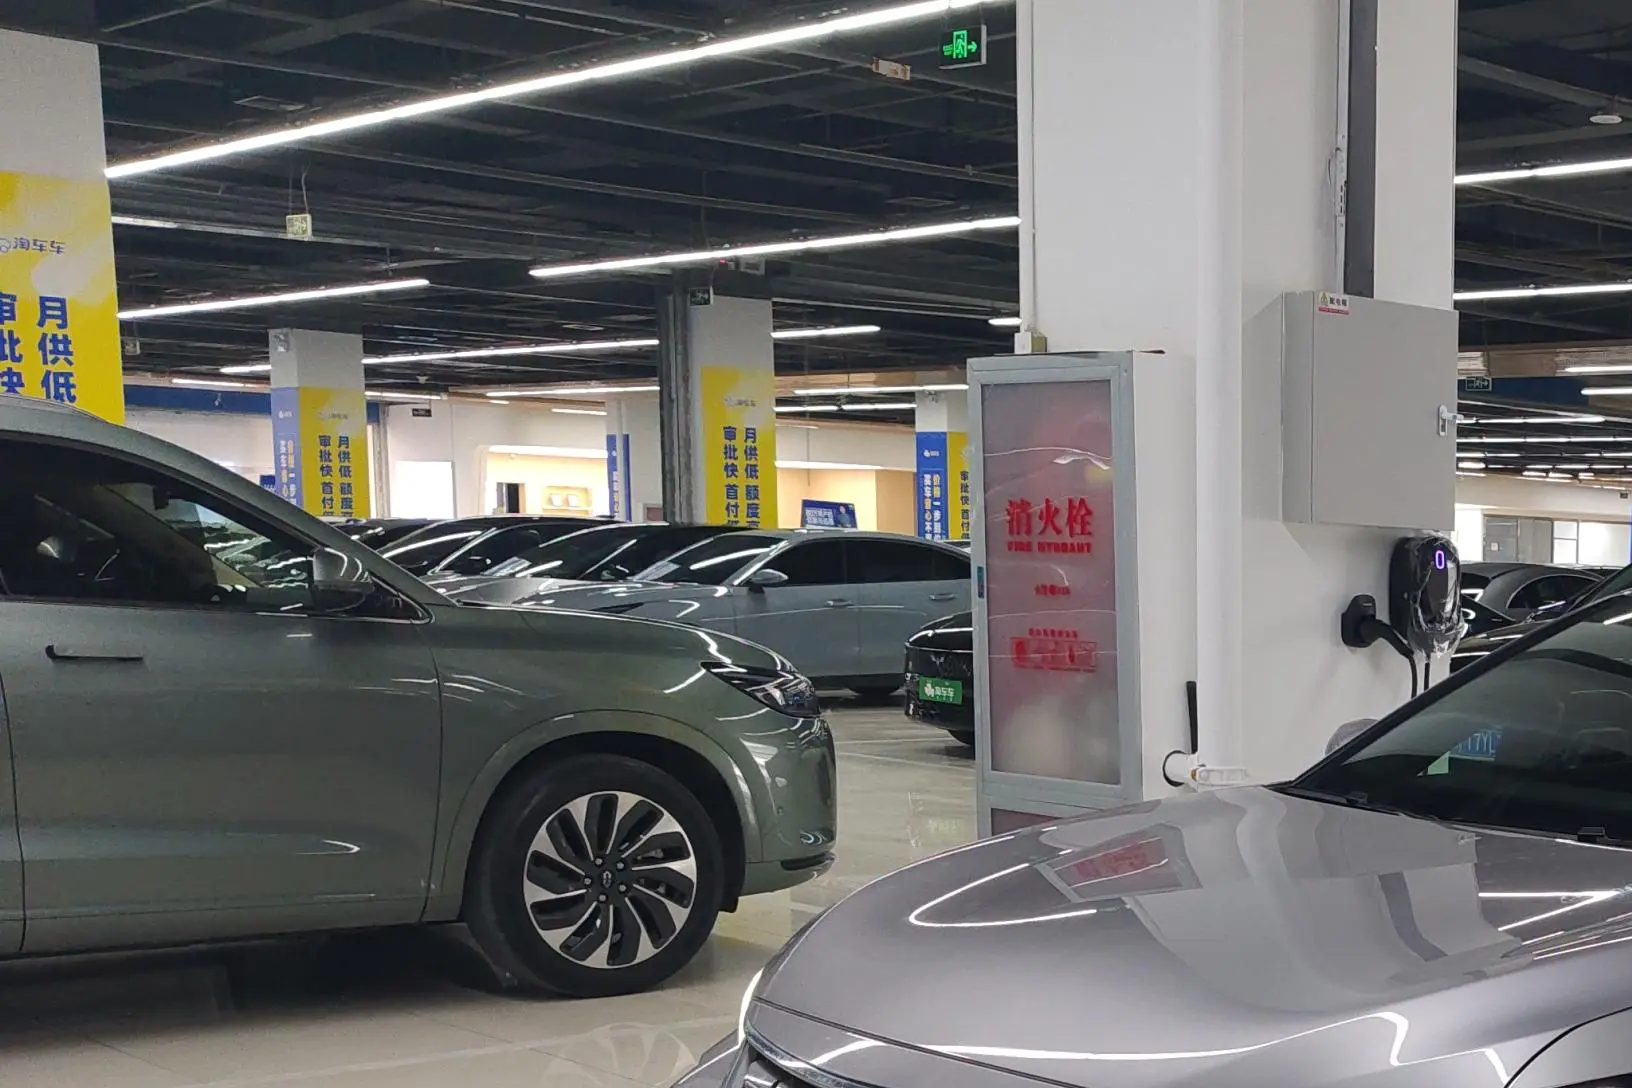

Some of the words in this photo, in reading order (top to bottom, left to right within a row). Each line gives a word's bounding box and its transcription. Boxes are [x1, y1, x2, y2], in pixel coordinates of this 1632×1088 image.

[13, 236, 66, 254] 淘车车
[37, 295, 77, 403] 月供低
[722, 426, 739, 479] 审批快
[743, 426, 760, 480] 月供低
[1006, 496, 1094, 538] 消火栓
